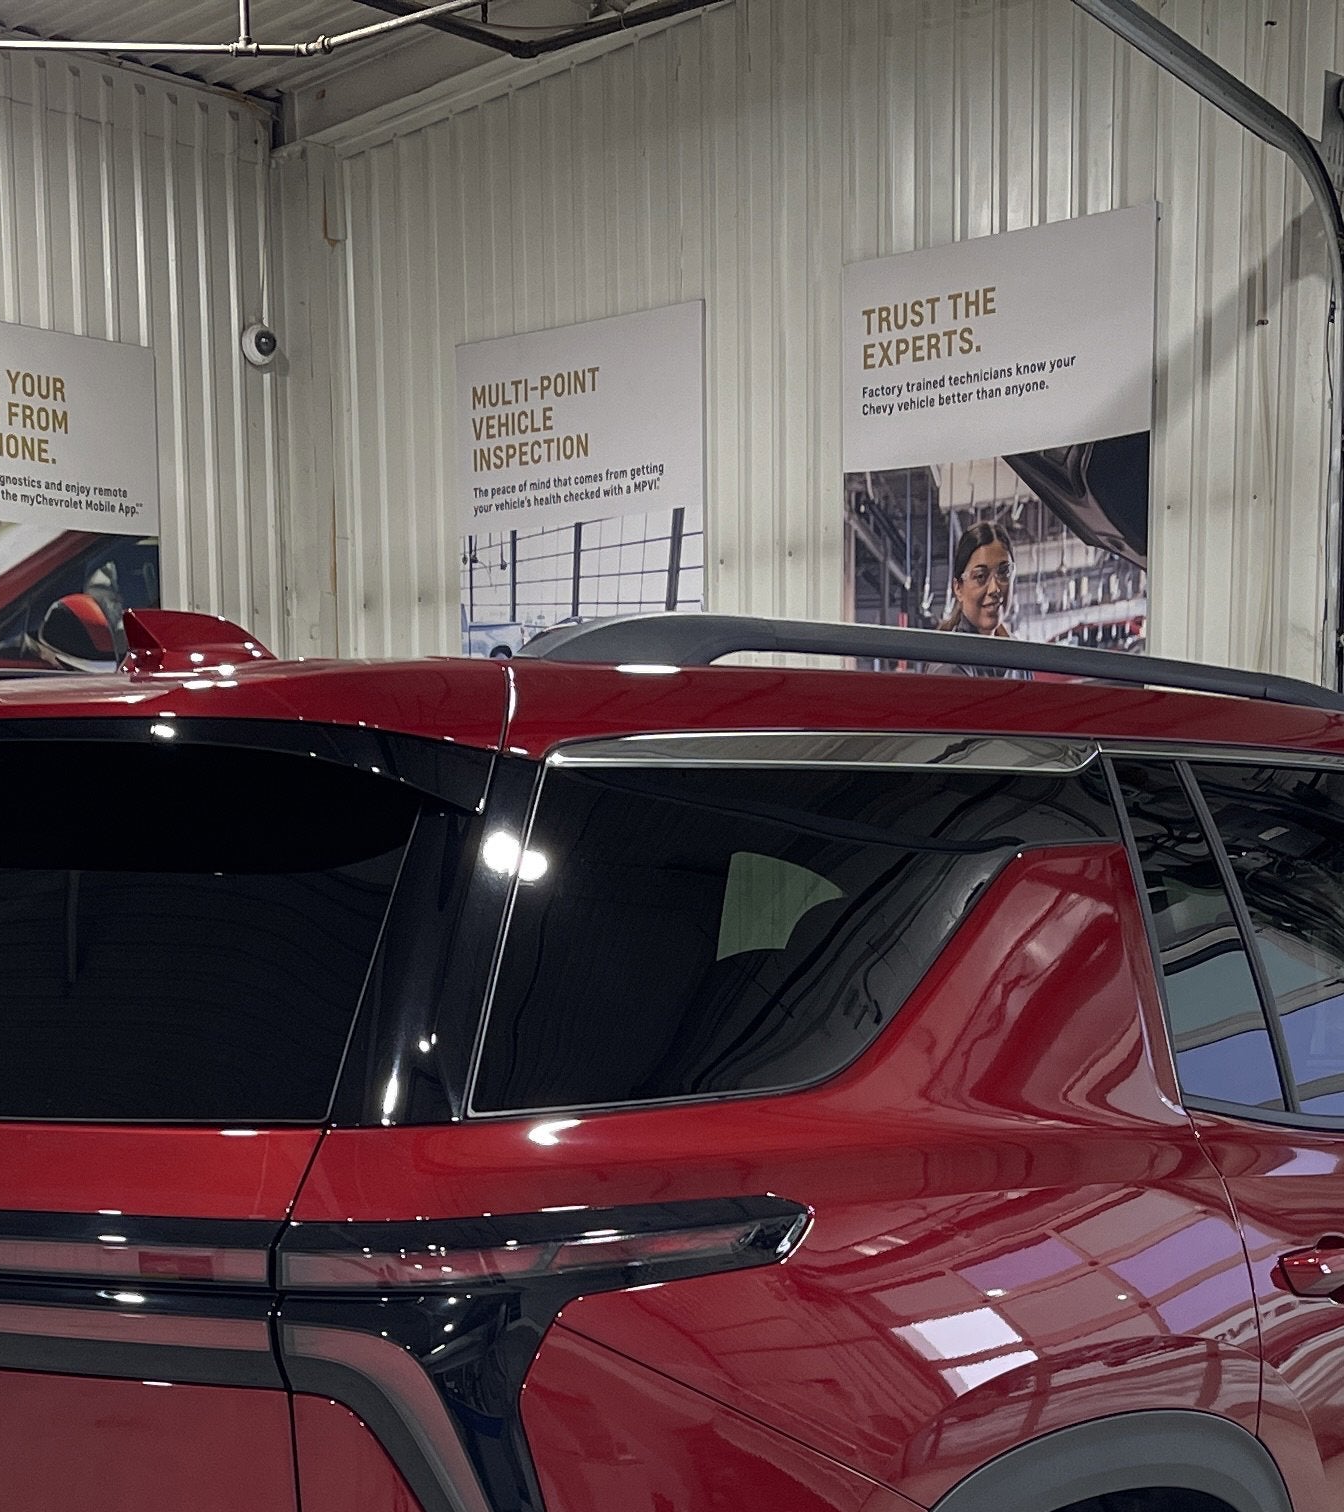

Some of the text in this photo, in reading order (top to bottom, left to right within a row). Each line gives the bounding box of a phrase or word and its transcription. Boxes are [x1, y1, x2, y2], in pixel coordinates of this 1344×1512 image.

[862, 286, 997, 335] TRUST THE
[863, 327, 982, 370] EXPERTS.
[6, 369, 66, 403] YOUR
[471, 366, 600, 411] MULTI-POINT
[862, 355, 1077, 400] Factory trained technicians know your
[862, 381, 1049, 417] Chevy vehicle better than anyone.
[7, 401, 69, 435] FROM
[471, 406, 554, 441] VEHICLE
[472, 432, 590, 473] INSPECTION
[45, 480, 62, 492] and
[65, 482, 91, 497] enjoy
[93, 487, 128, 498] remote
[473, 461, 665, 499] The peace of mind that comes from getting
[1, 489, 18, 502] the
[20, 493, 83, 510] myChevrolet
[85, 499, 116, 513] Mobile
[473, 503, 493, 518] your
[533, 491, 562, 507] health
[563, 485, 601, 503] checked
[603, 483, 624, 497] with
[625, 485, 632, 495] a
